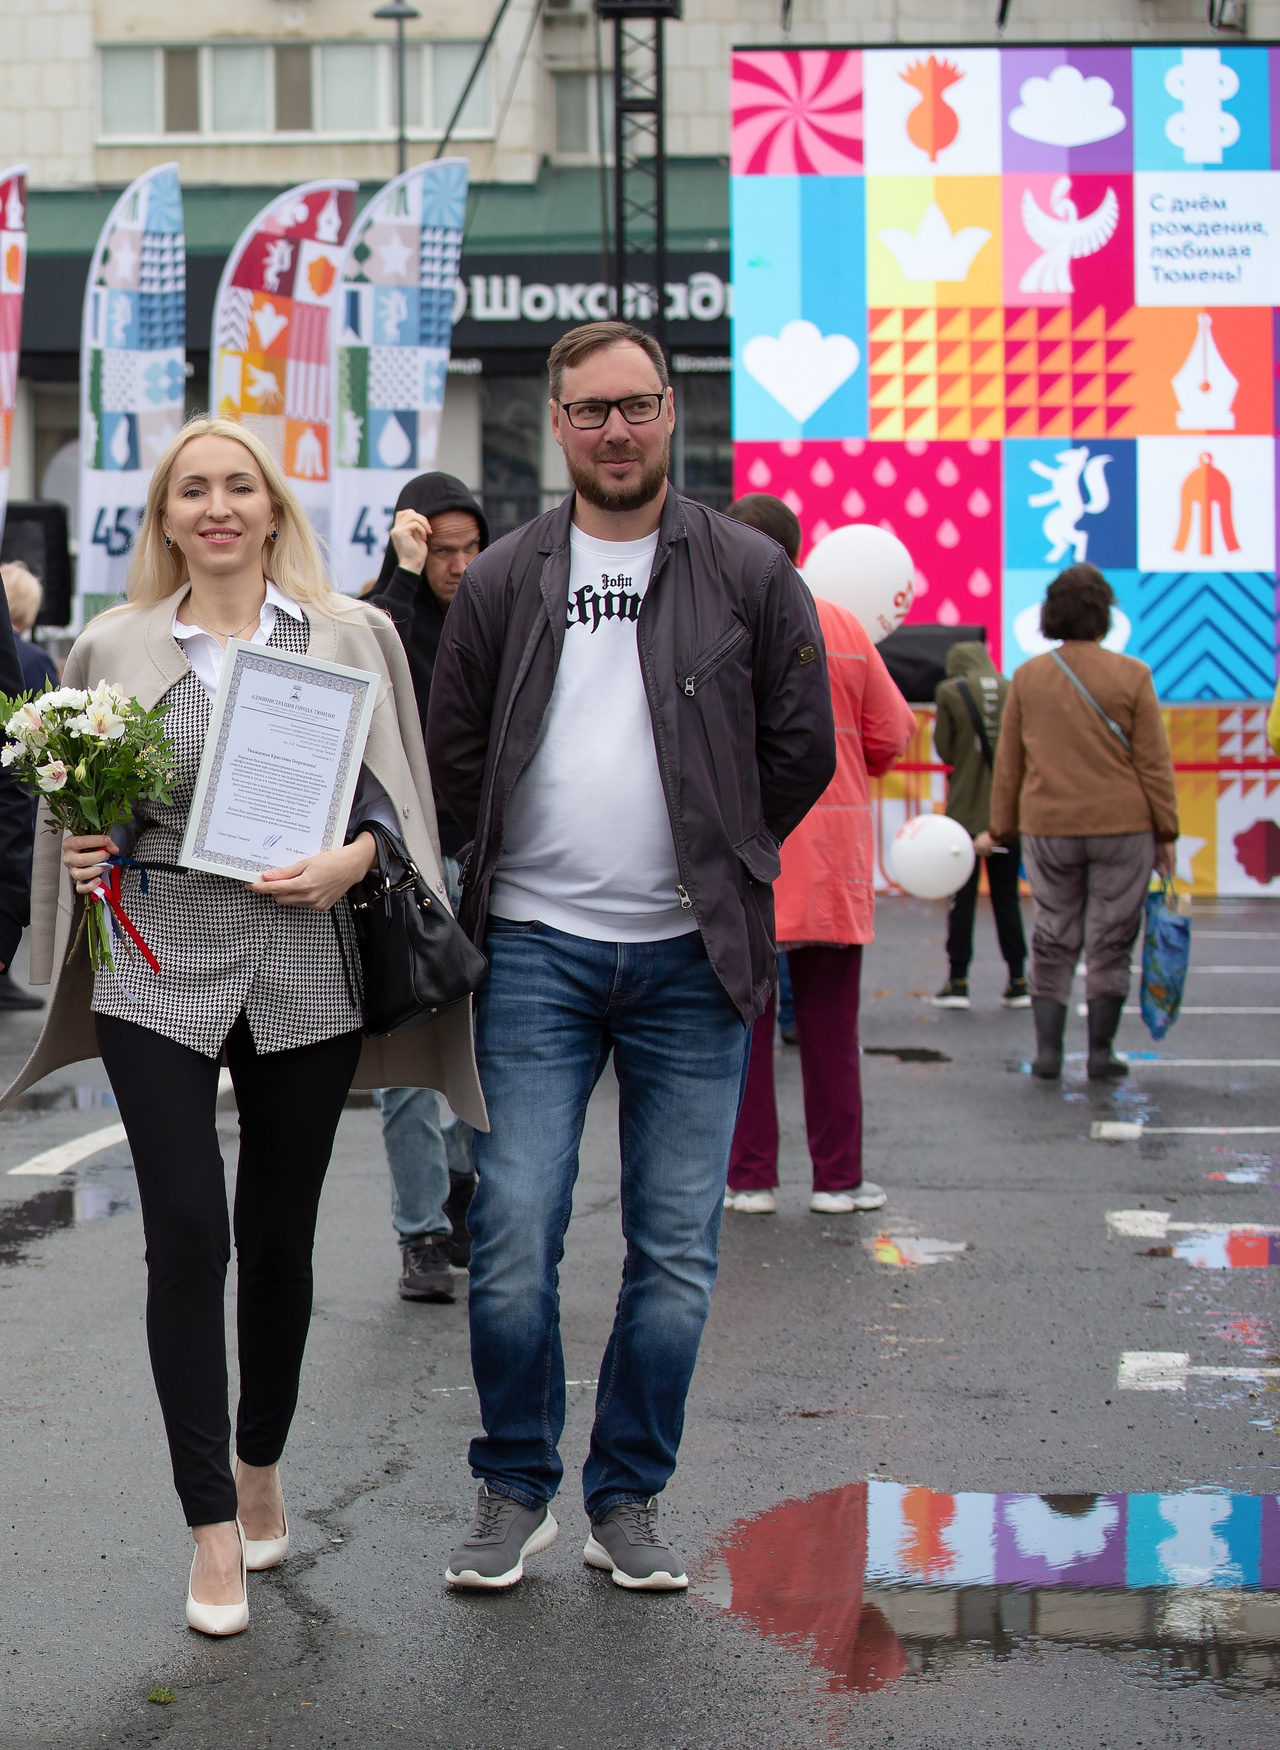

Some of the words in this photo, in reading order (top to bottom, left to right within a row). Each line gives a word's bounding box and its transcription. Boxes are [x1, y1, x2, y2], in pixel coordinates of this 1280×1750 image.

[1150, 193, 1165, 212] С
[1170, 192, 1228, 214] днём
[1150, 220, 1269, 239] рождения,
[1150, 241, 1252, 260] любимая
[1151, 264, 1242, 284] Тюмень!
[470, 271, 731, 321] Шоколад
[601, 573, 632, 590] John
[295, 704, 313, 715] ГОРОДА
